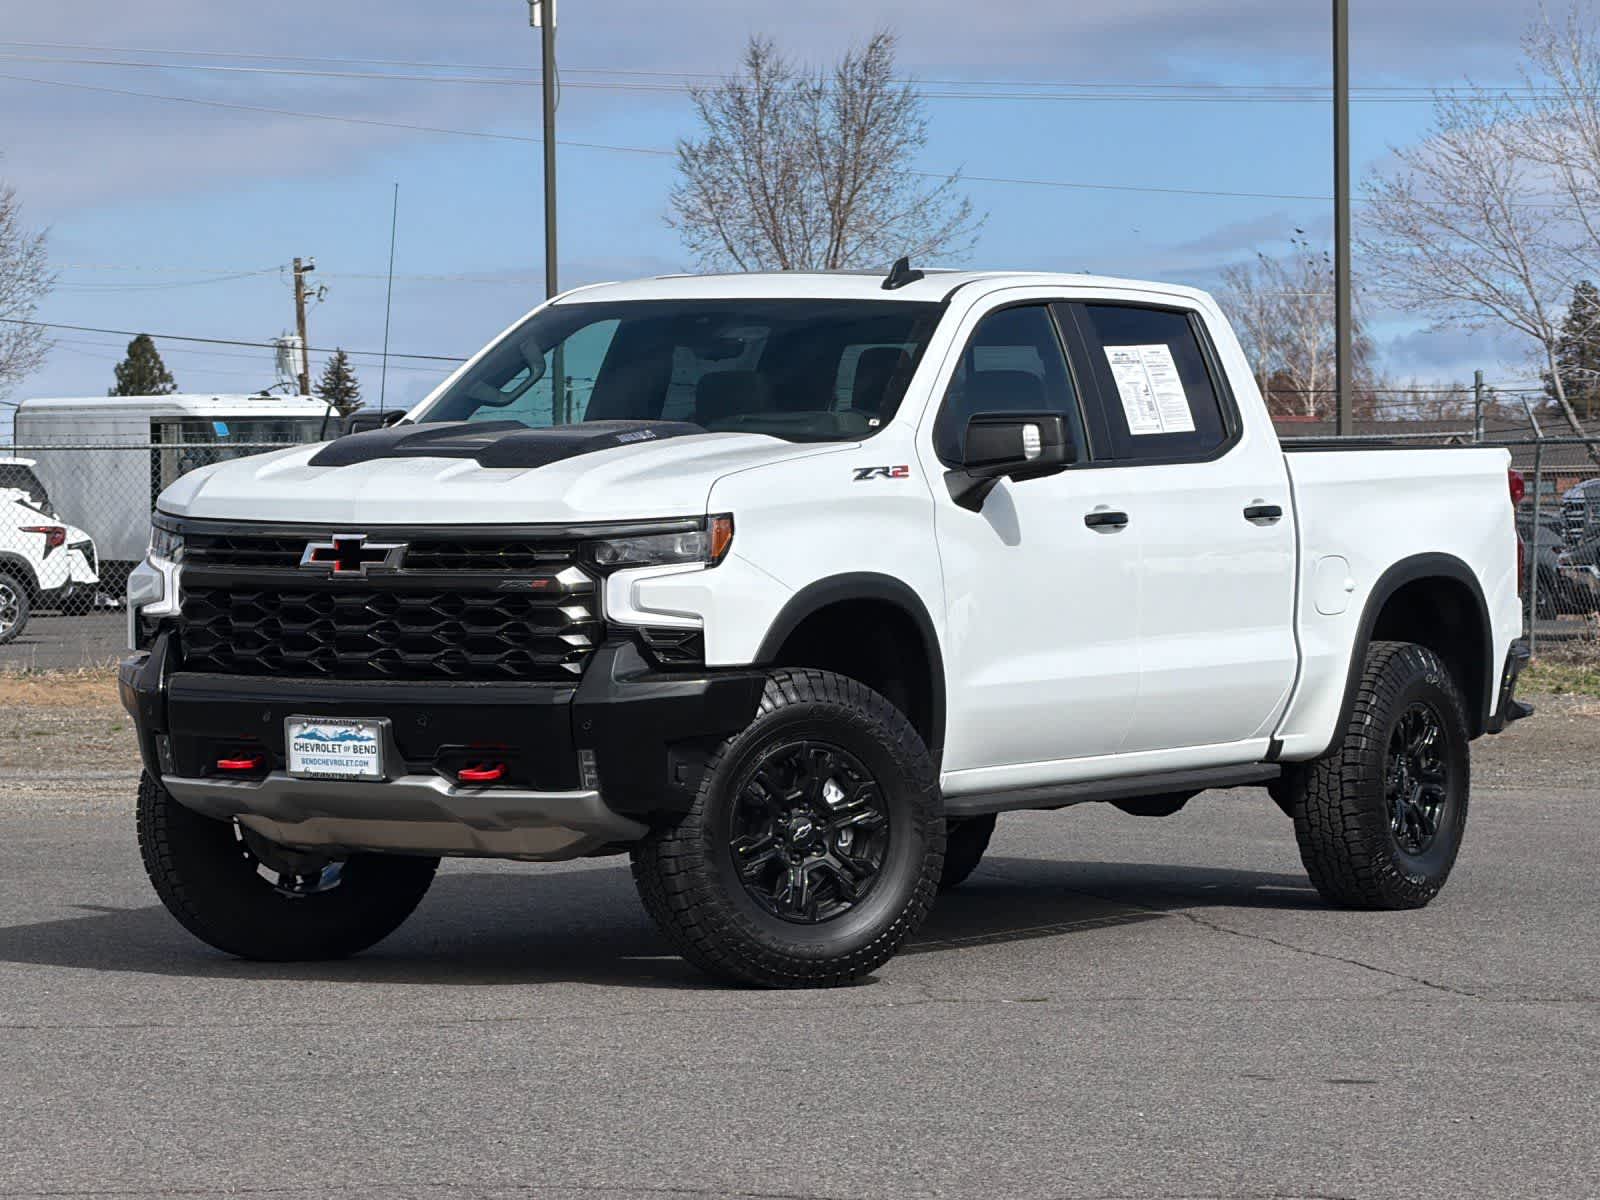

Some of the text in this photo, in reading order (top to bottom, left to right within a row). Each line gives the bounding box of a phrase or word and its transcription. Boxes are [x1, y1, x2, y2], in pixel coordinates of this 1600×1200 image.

[853, 464, 910, 482] ZR2
[293, 742, 342, 753] CHEVROLET
[352, 744, 377, 754] BEND
[301, 757, 369, 767] BENDCHEVROLET.COM
